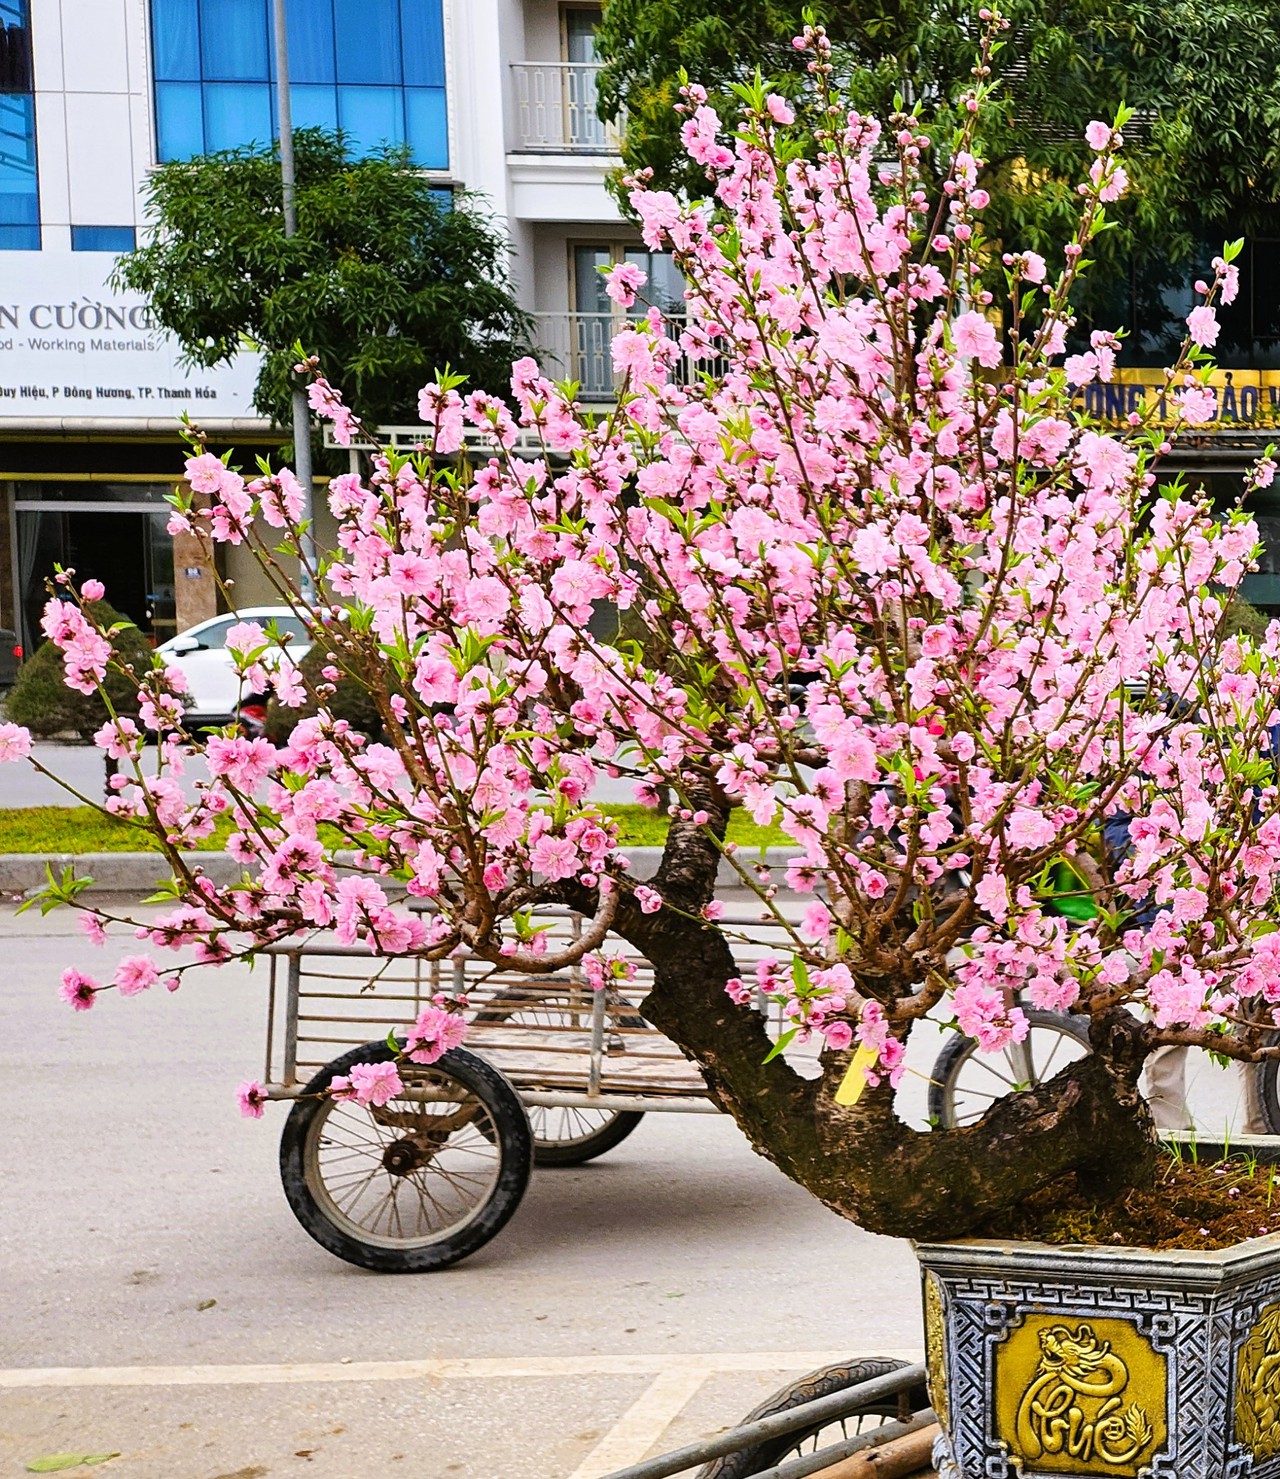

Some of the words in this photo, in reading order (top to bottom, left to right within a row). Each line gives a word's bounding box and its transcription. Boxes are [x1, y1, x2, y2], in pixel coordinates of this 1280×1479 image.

[28, 338, 85, 353] Working
[90, 338, 155, 350] Materials
[52, 387, 59, 398] P
[138, 387, 155, 399] TP.
[157, 387, 192, 399] Thanh
[195, 386, 217, 399] Hóa
